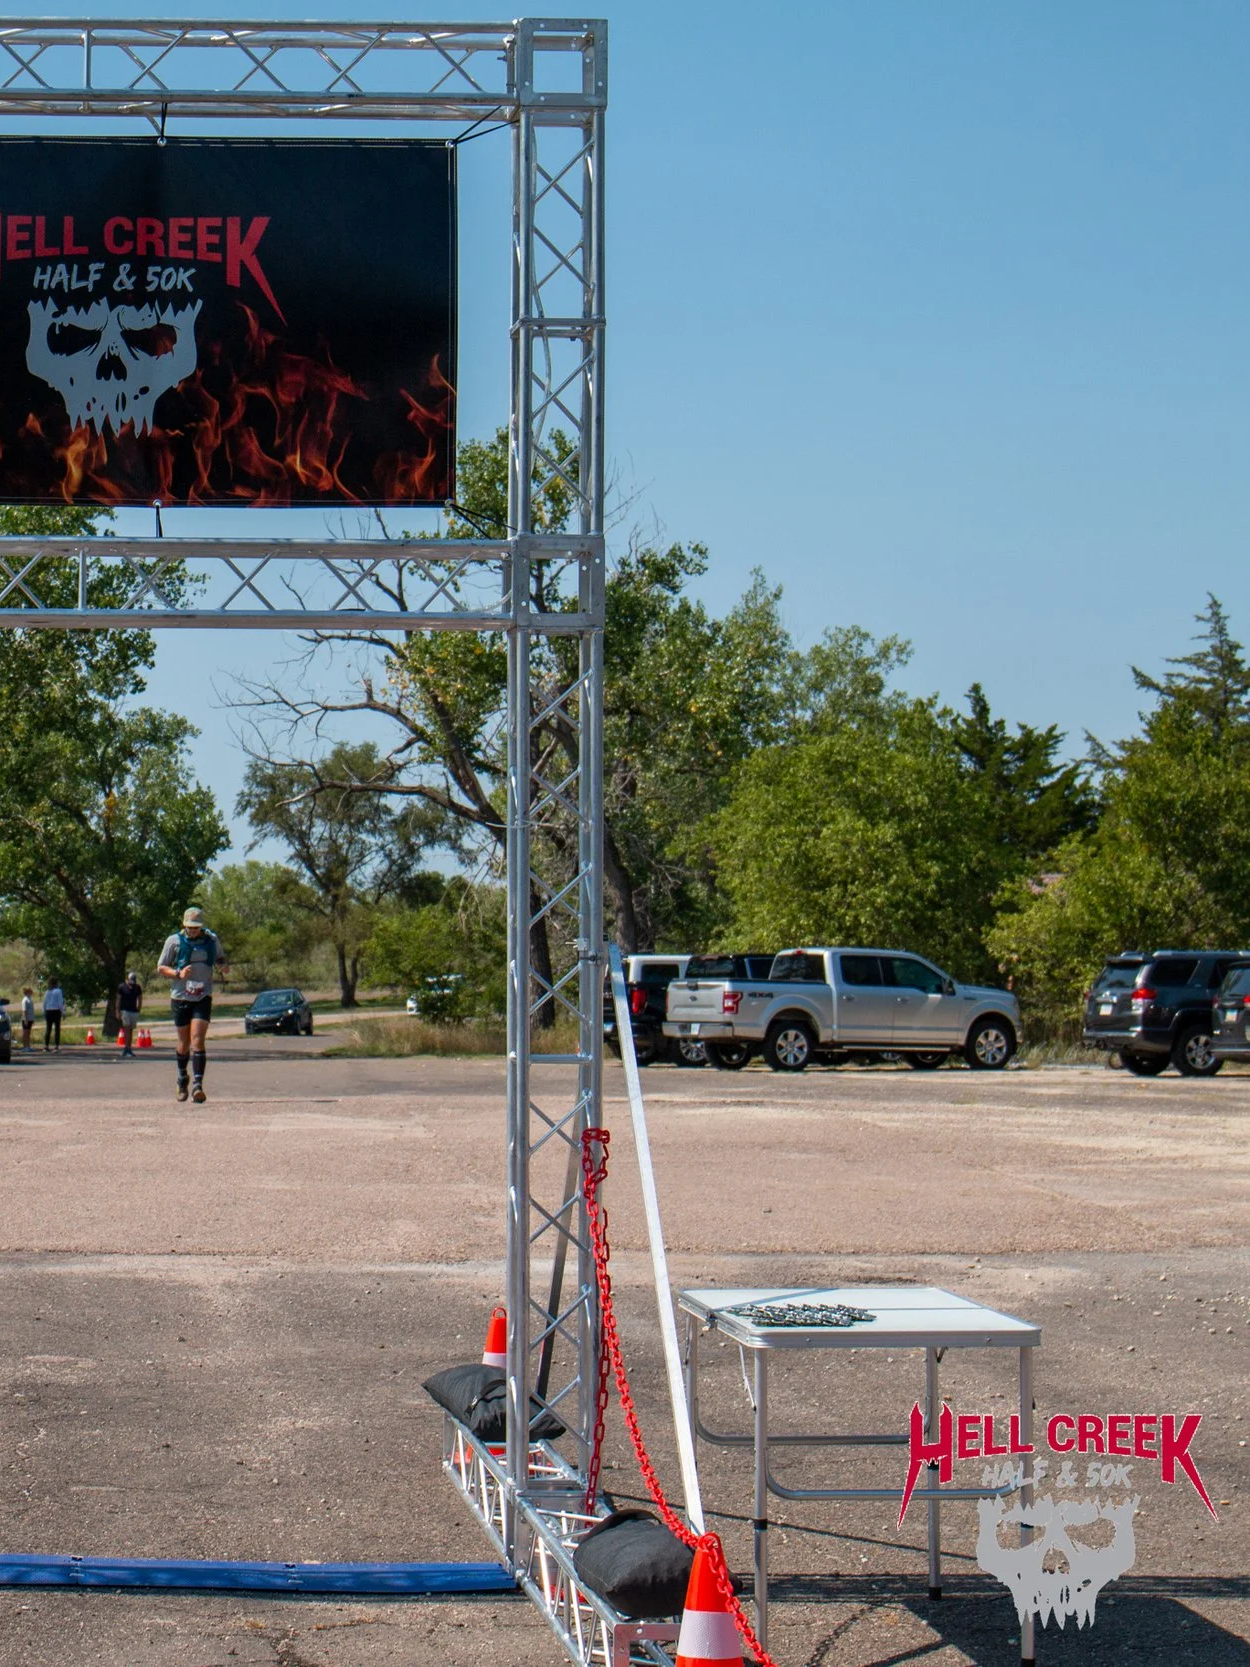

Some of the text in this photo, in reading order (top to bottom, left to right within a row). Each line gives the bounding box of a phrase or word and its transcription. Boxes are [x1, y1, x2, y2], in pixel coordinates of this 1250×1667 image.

[32, 262, 197, 293] HALF & 50K
[103, 215, 288, 327] CREEK
